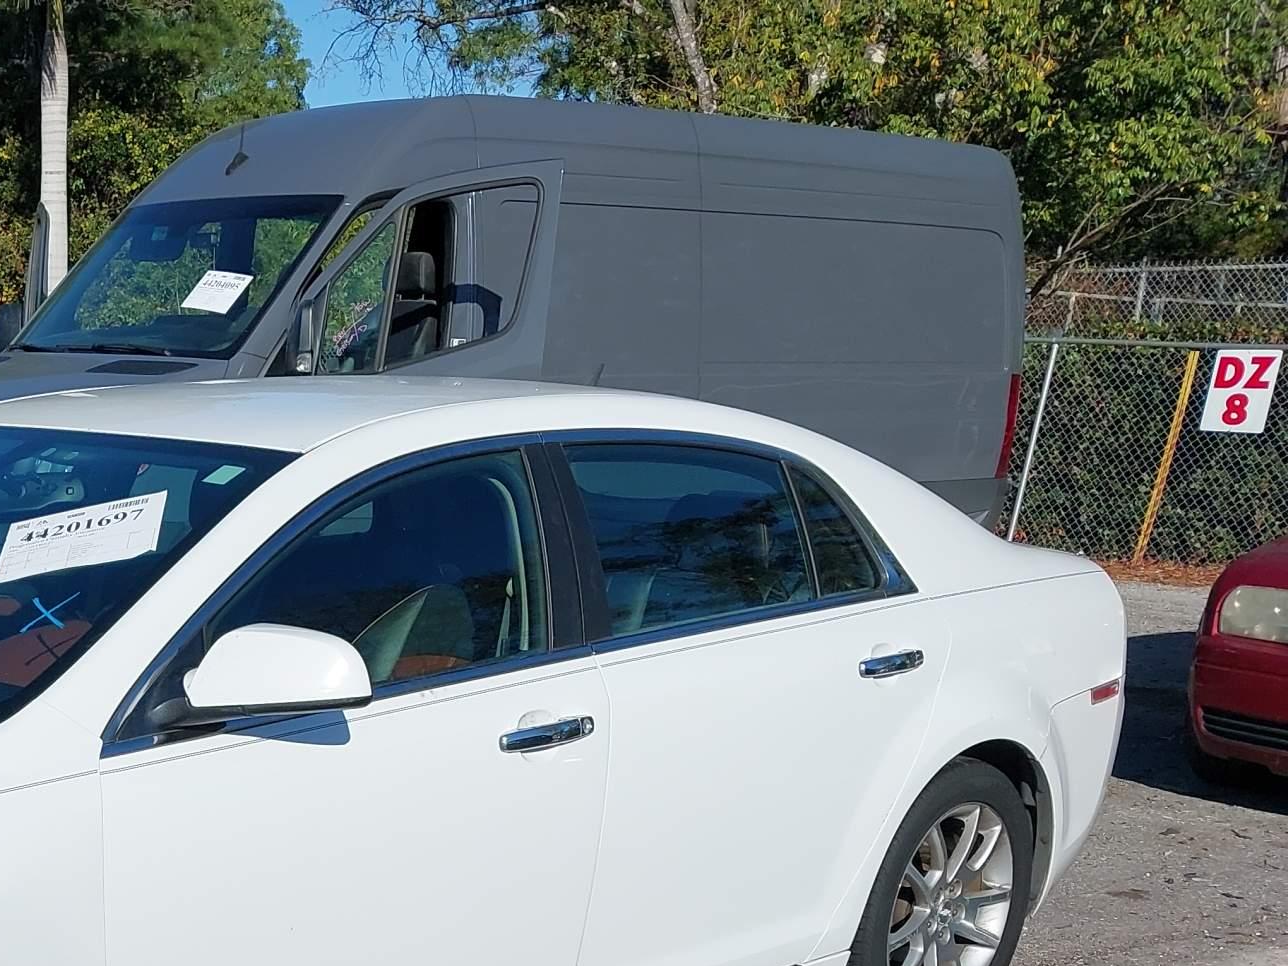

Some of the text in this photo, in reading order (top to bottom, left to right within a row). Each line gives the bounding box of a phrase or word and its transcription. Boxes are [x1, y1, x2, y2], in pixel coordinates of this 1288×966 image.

[1213, 356, 1277, 390] DZ
[1221, 393, 1249, 426] 8
[20, 509, 144, 542] 44201697
